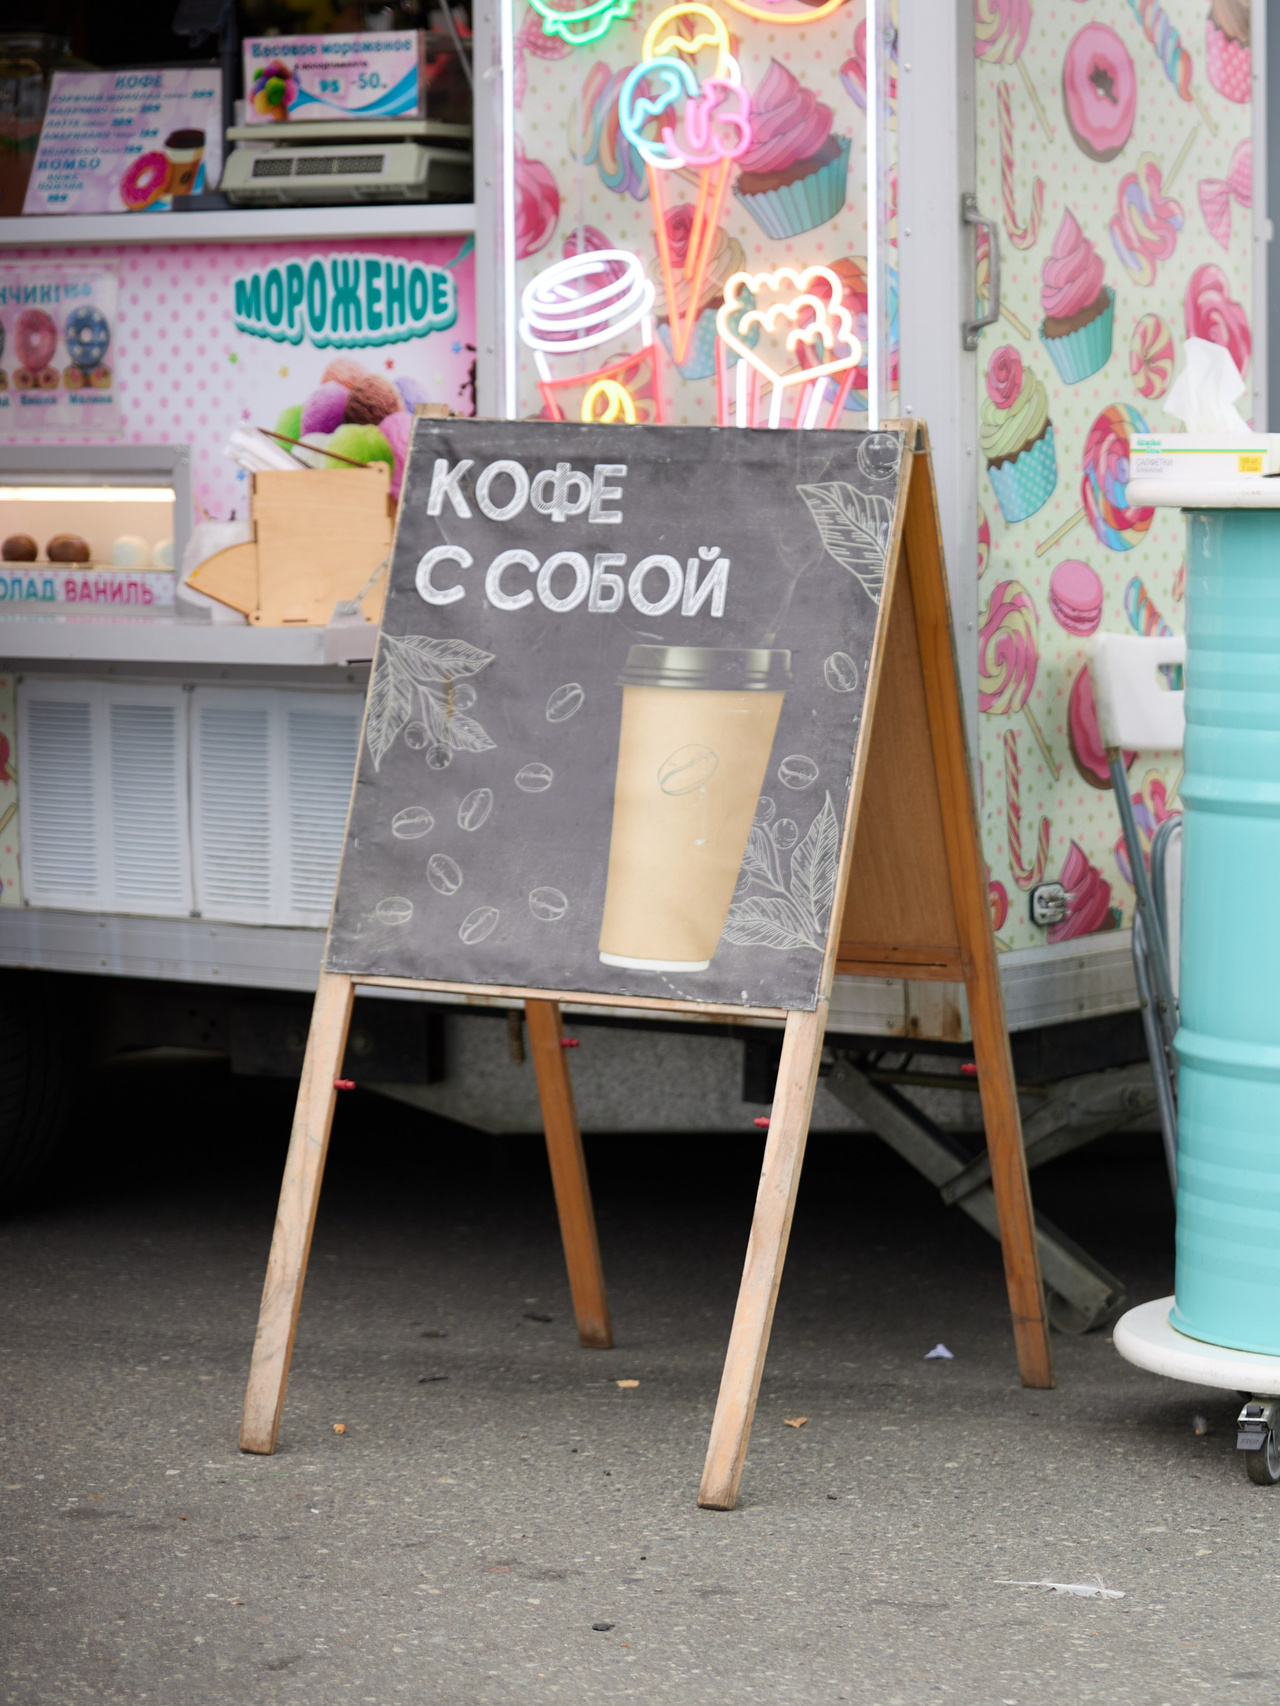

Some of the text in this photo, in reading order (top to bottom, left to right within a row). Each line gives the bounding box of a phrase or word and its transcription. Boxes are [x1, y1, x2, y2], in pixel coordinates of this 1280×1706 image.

[114, 74, 164, 89] КОФЕ
[234, 257, 451, 338] МОРОЖЕНОЕ
[425, 457, 629, 525] КОФЕ
[64, 578, 155, 605] ВАНИЛЬ
[414, 543, 731, 619] С СОБОЙ
